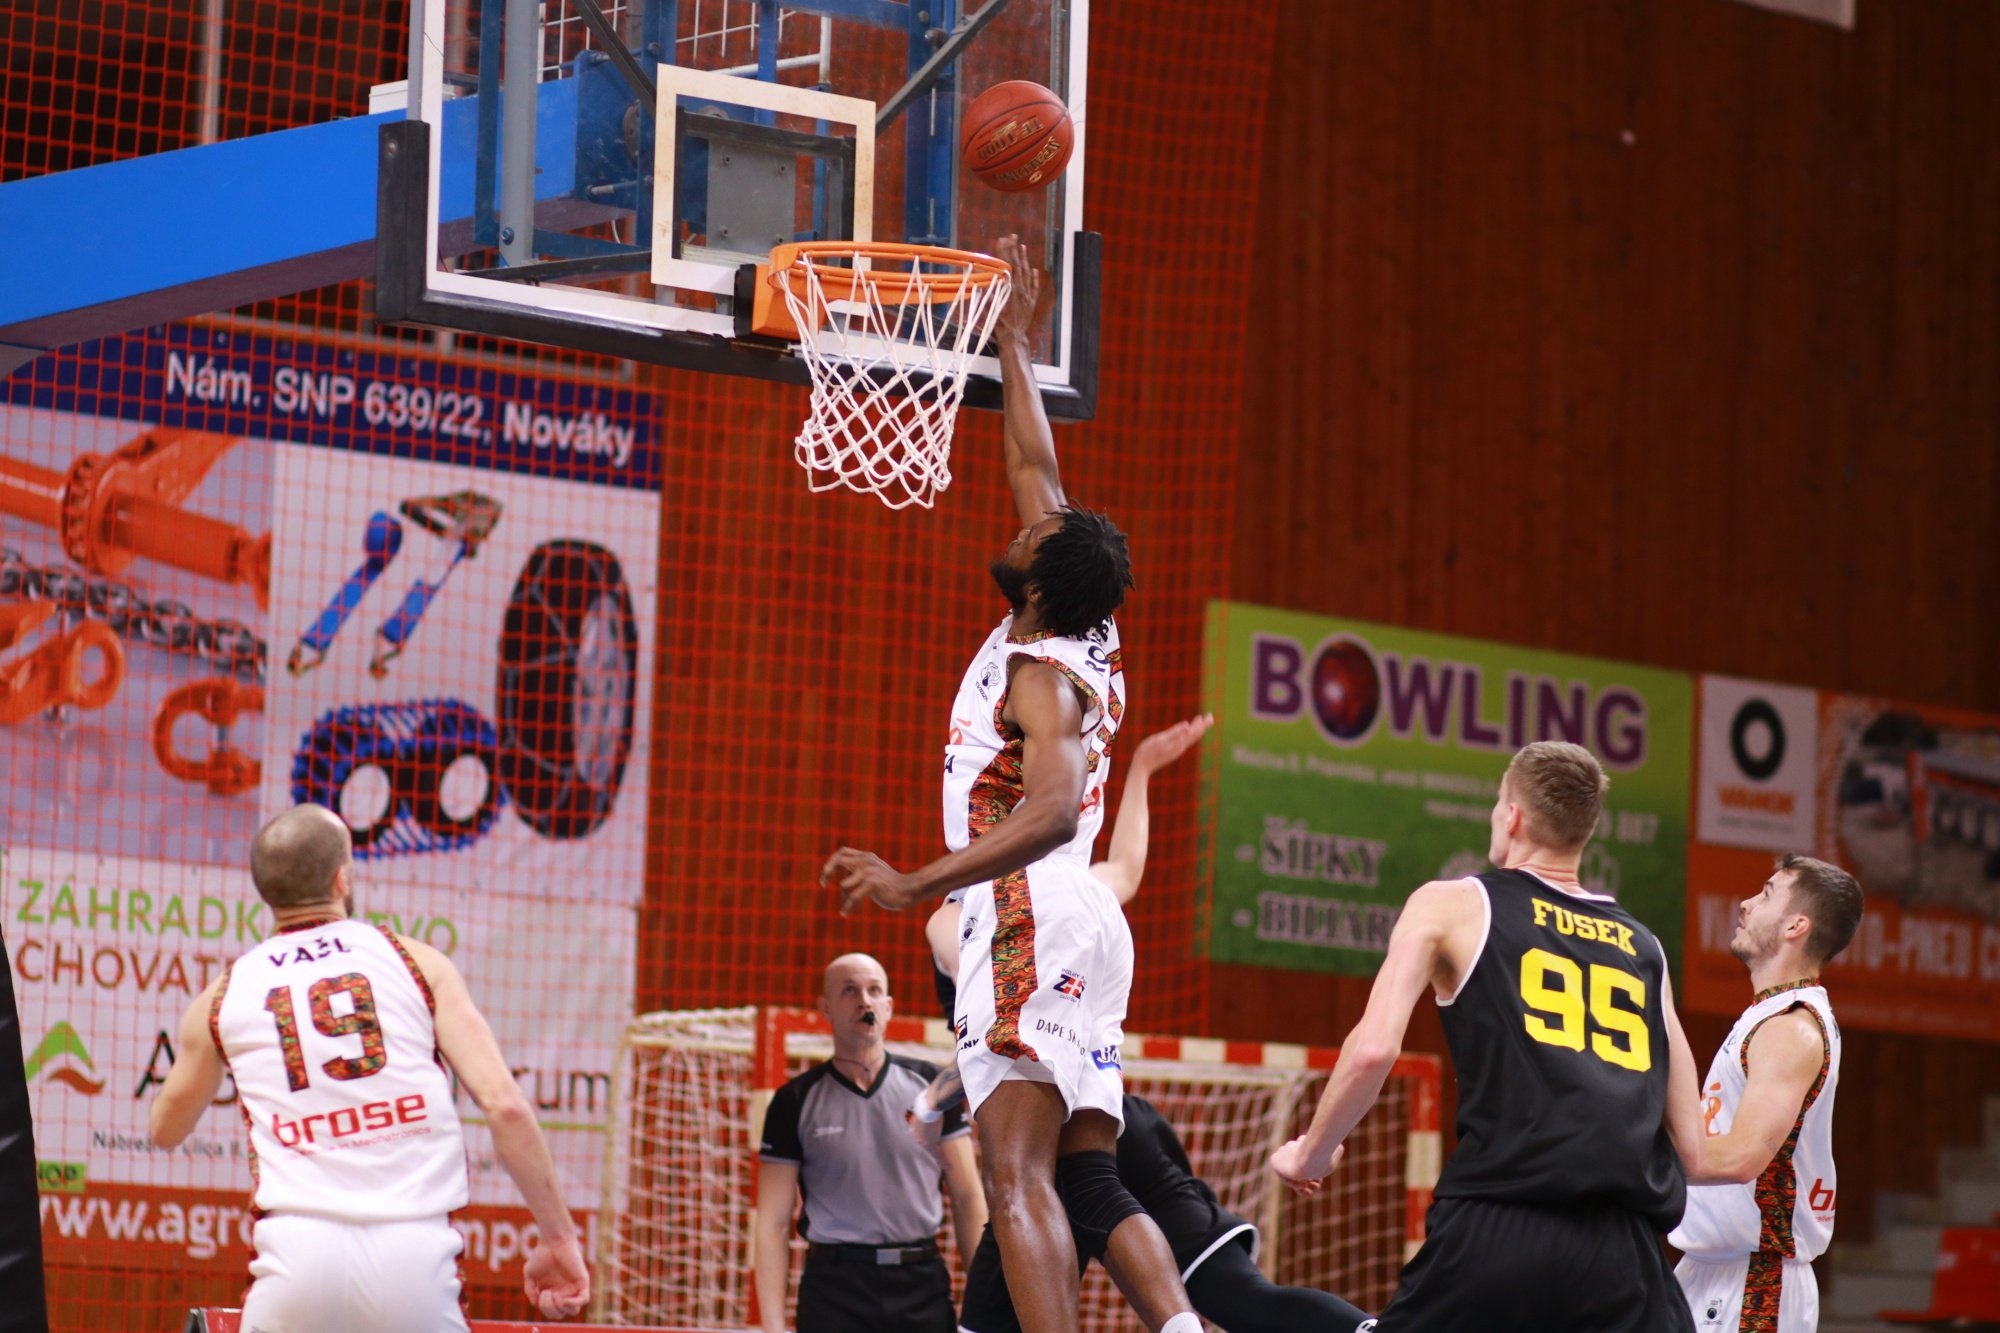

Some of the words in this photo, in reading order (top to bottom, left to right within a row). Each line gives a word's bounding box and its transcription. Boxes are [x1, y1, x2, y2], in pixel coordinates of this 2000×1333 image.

[166, 350, 263, 408] Nám.
[273, 366, 357, 418] SNP
[363, 380, 493, 447] 639/22,
[502, 399, 636, 468] Nováky
[1531, 897, 1637, 957] FUSEK
[263, 971, 388, 1093] 19
[1520, 946, 1652, 1073] 95
[271, 1093, 429, 1148] brose
